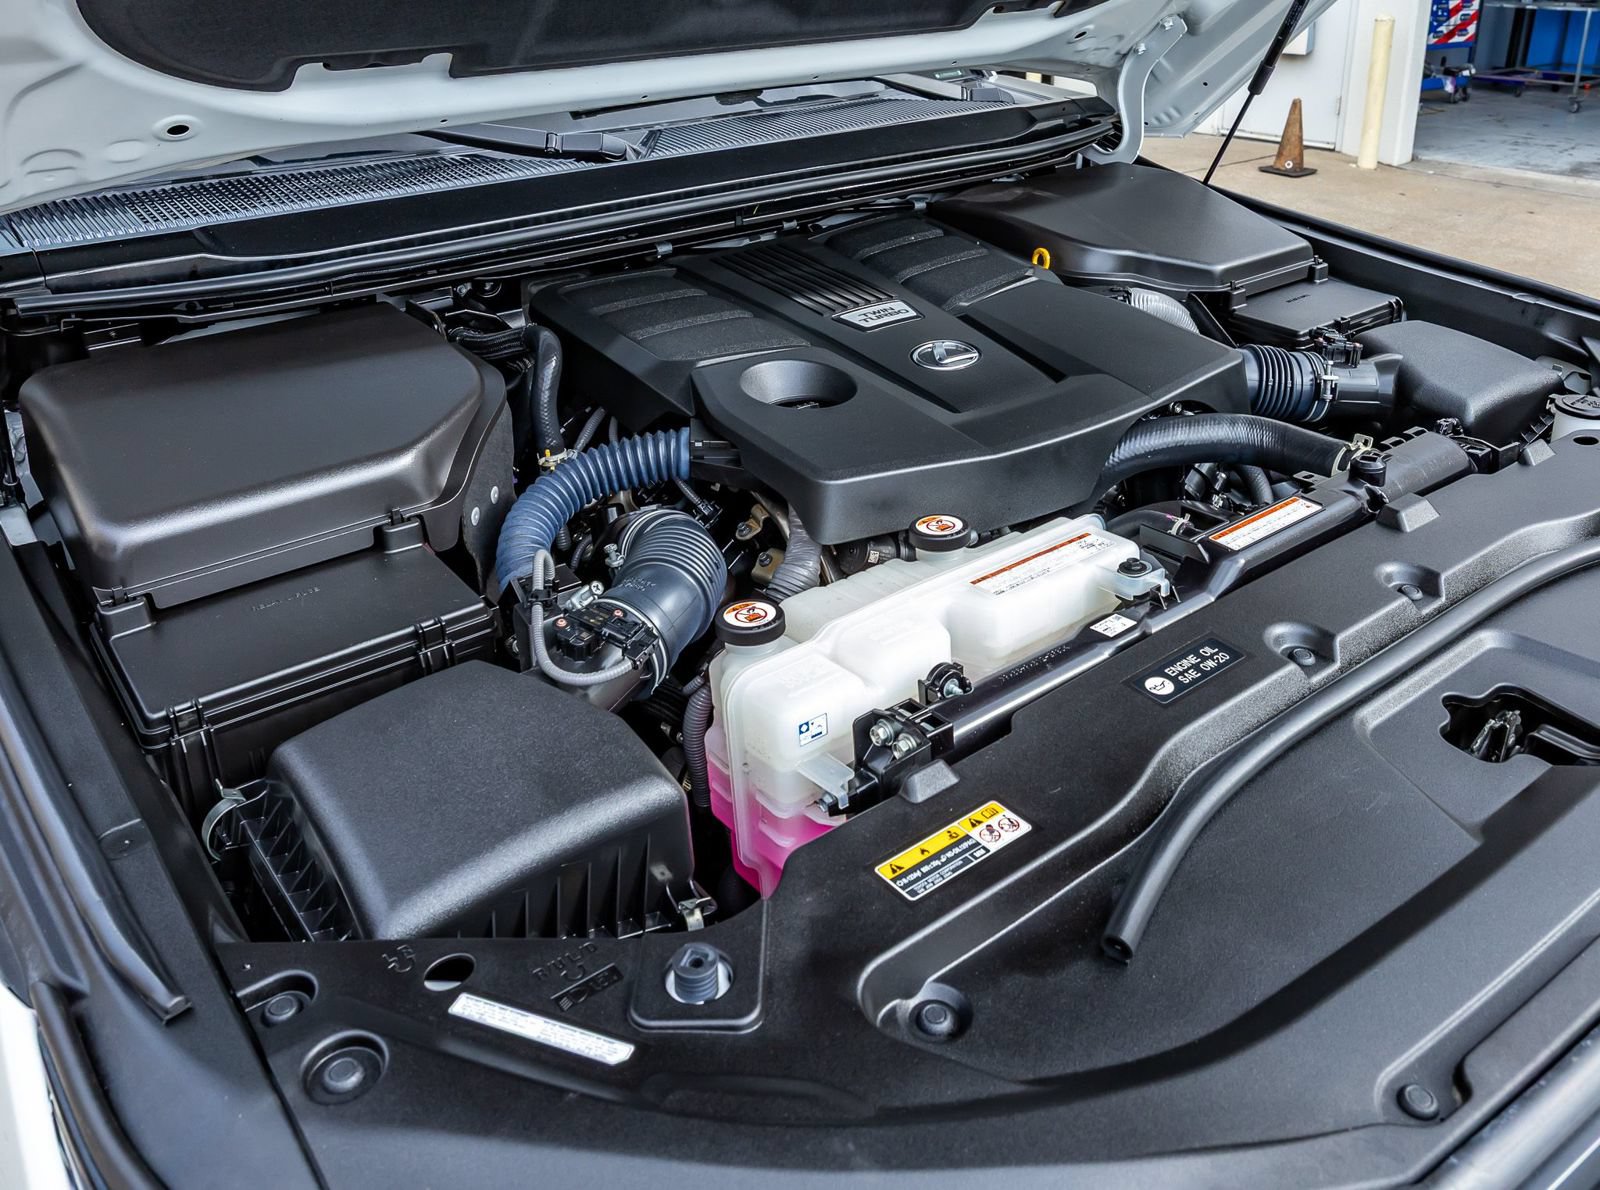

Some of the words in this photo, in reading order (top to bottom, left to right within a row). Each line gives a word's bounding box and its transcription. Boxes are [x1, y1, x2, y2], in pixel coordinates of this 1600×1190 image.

[858, 307, 895, 317] TWIN
[859, 309, 909, 323] TURBO
[1164, 654, 1201, 677] ENGINE
[1199, 646, 1219, 657] OIL
[1178, 669, 1202, 684] SAE
[1200, 652, 1230, 671] 0W-20
